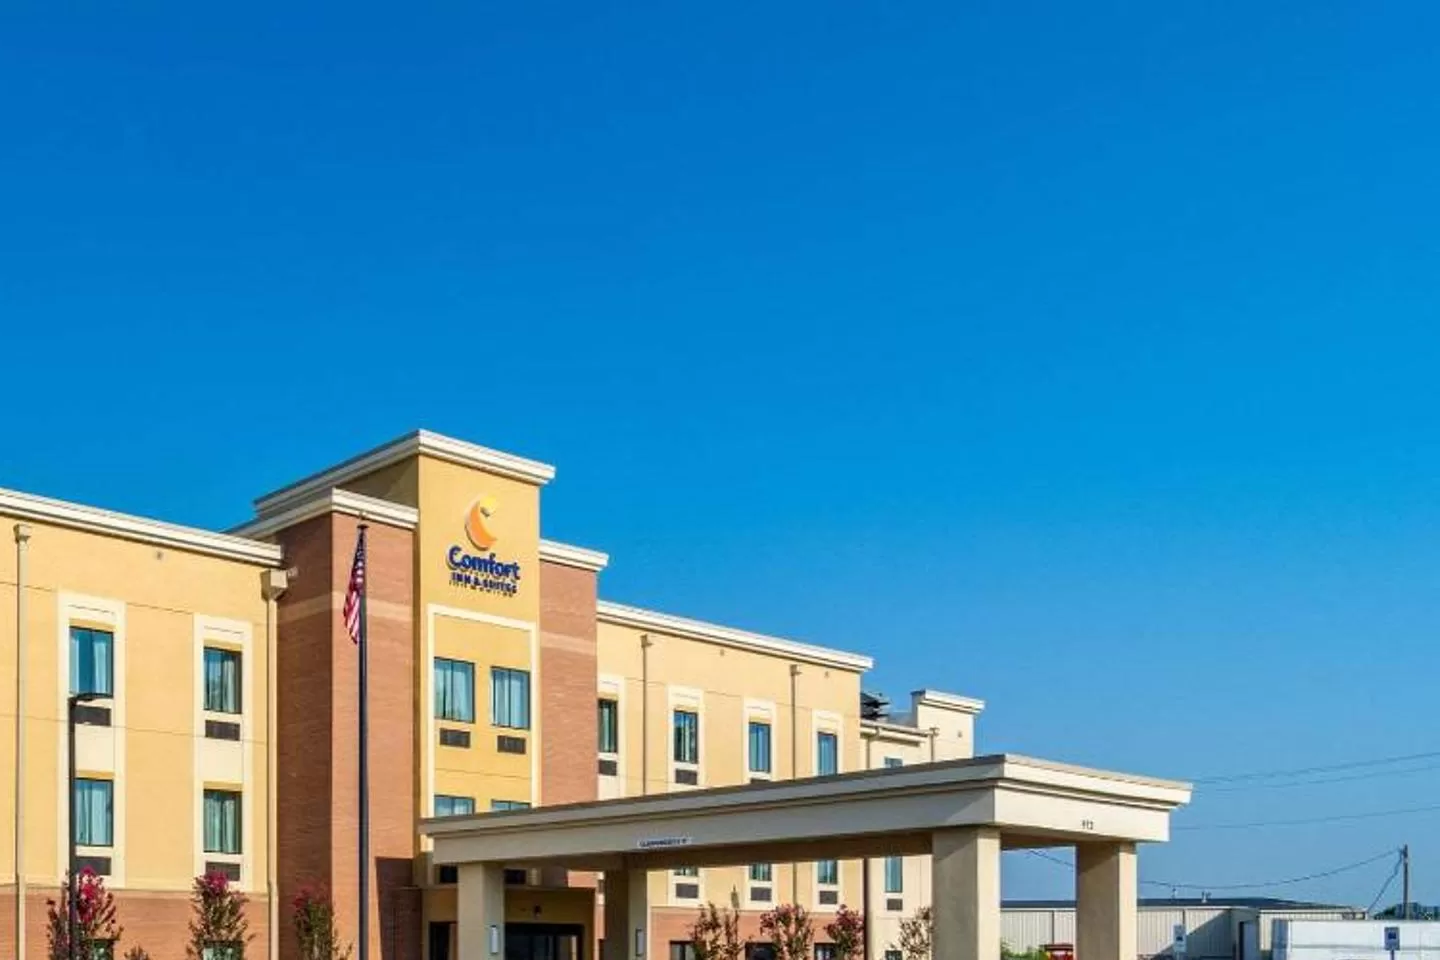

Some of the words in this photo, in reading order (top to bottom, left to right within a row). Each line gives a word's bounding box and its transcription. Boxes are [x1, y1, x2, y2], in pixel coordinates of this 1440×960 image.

[447, 545, 521, 580] Comfort
[451, 572, 471, 584] INN
[483, 578, 518, 594] SUITES
